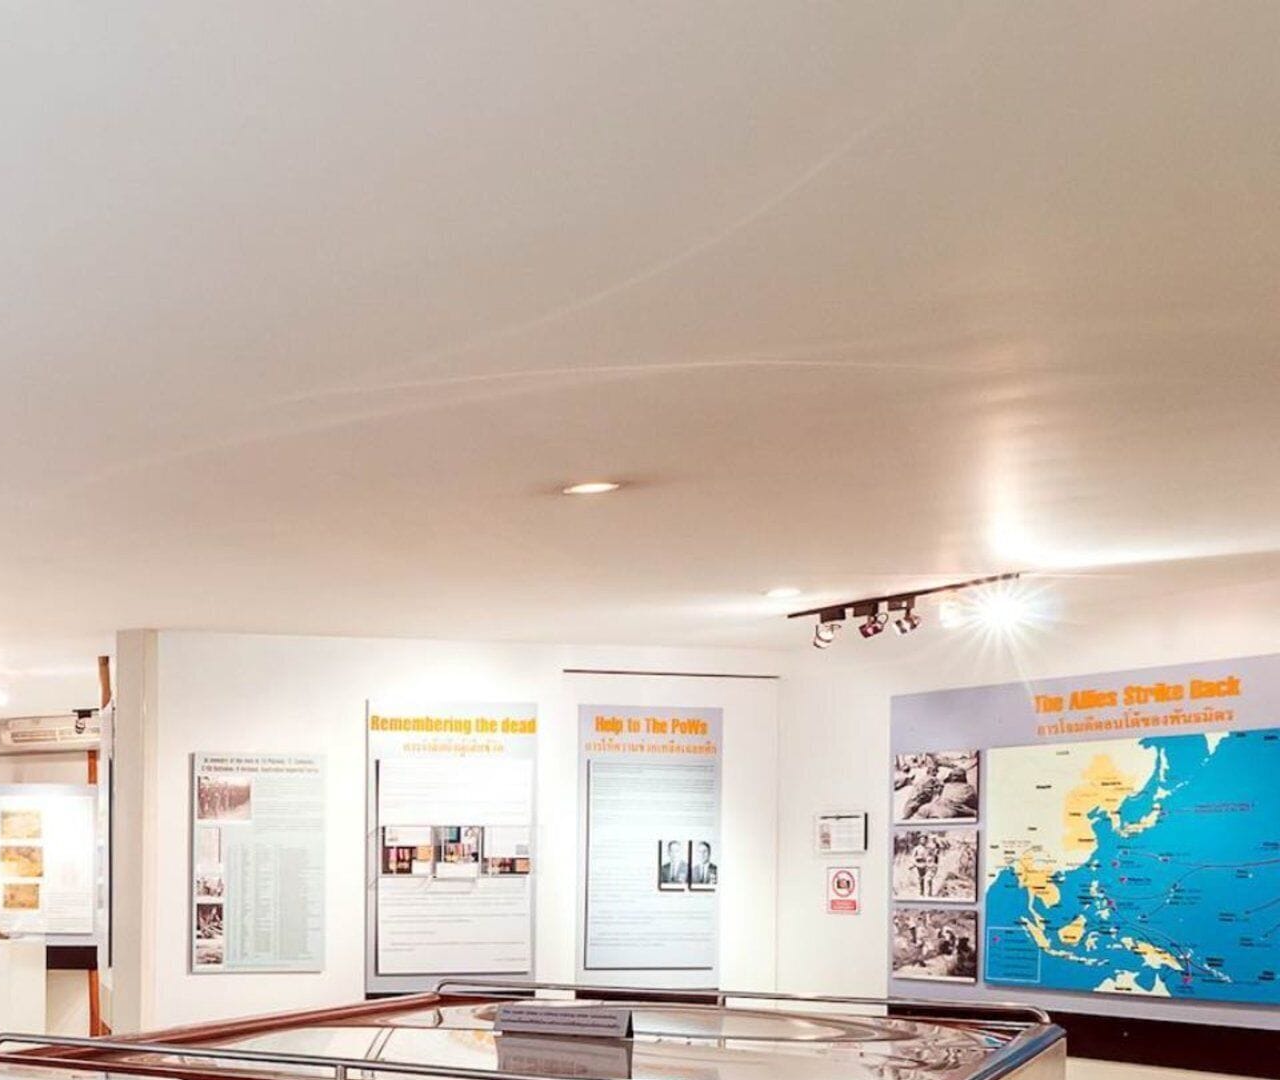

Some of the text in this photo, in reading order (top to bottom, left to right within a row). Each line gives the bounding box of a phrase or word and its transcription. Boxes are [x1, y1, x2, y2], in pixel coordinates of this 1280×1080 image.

[1035, 676, 1241, 713] The Allies Strike Back
[371, 716, 537, 735] Remembering the dead
[595, 716, 708, 735] Help to The PoWs
